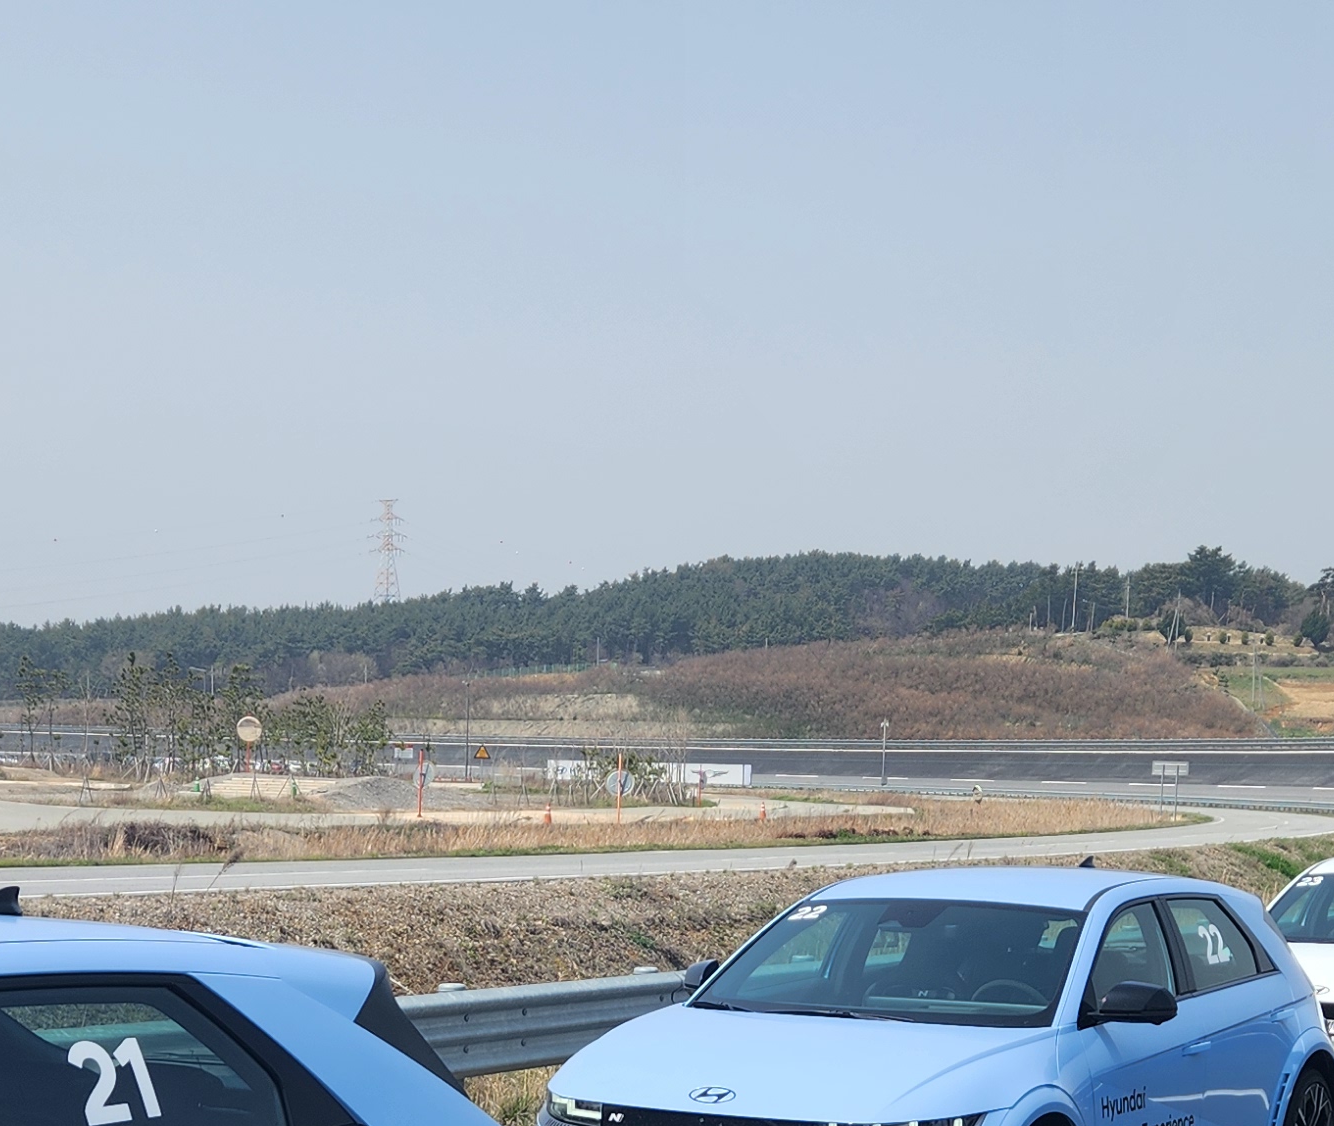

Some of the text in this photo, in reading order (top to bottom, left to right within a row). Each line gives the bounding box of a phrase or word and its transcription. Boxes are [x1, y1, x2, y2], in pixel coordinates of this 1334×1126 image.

[787, 905, 828, 920] 22
[1197, 923, 1231, 965] 22
[67, 1037, 162, 1126] 21
[1100, 1085, 1147, 1122] Hyundai
